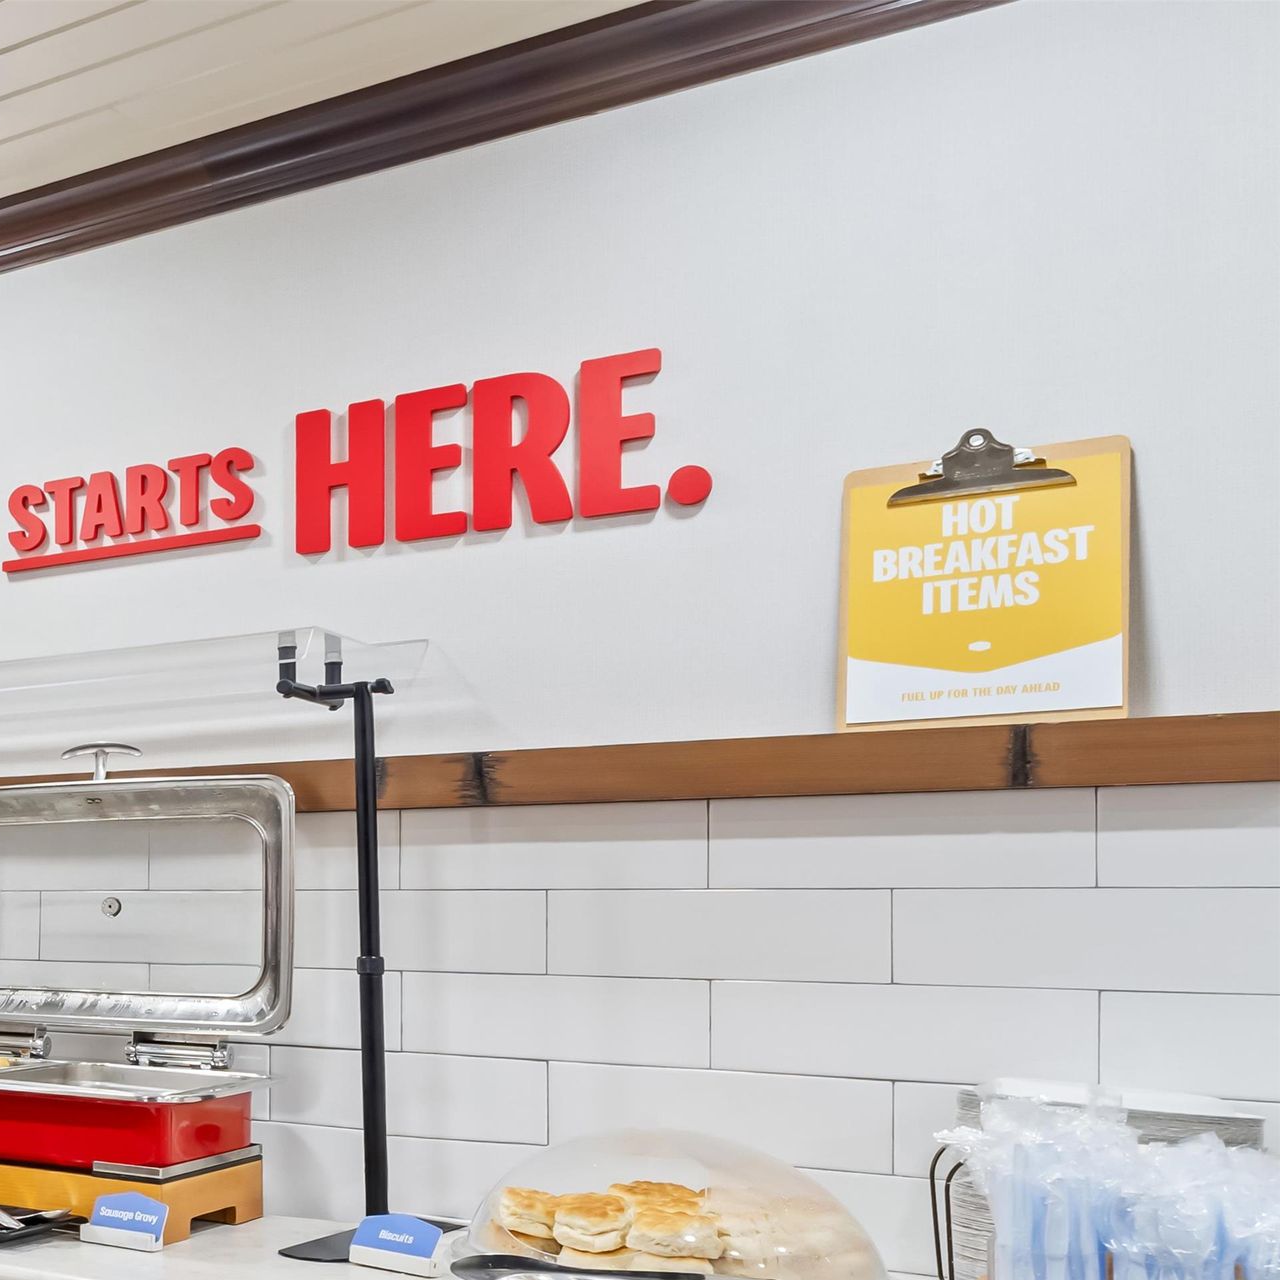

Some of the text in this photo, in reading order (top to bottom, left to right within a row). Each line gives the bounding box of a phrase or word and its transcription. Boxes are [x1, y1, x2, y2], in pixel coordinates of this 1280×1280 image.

[7, 447, 255, 553] STARTS
[295, 348, 714, 556] HERE.
[941, 495, 1020, 538] HOT
[872, 525, 1096, 583] BREAKFAST
[921, 570, 1040, 616] ITEMS
[901, 682, 1061, 703] FUEL UP FOR THE DAY AHEAD
[99, 1206, 159, 1225] Sausage Gravy
[378, 1229, 415, 1245] Biscuits
